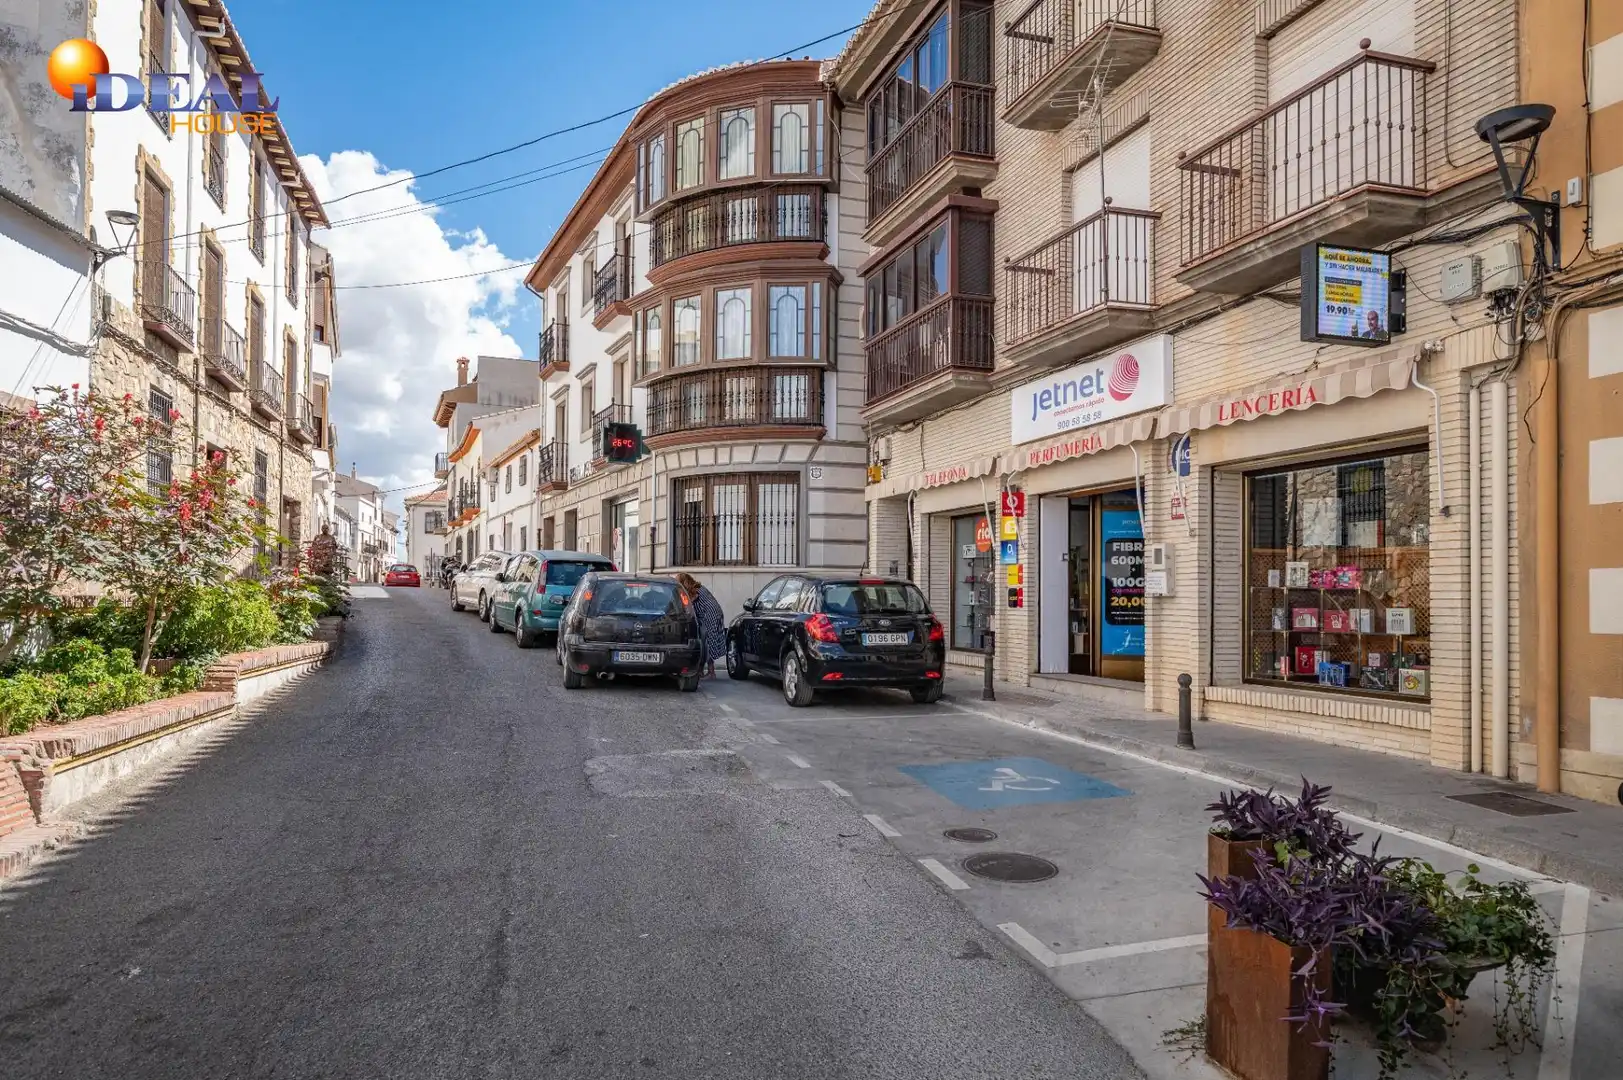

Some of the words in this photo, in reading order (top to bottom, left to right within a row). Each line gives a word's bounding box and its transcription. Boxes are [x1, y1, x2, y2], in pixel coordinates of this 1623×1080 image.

[1031, 368, 1105, 421] jetnet
[1057, 419, 1070, 430] 900
[1071, 416, 1081, 426] 58
[1082, 413, 1091, 424] 58
[1093, 410, 1102, 421] 58
[1112, 542, 1144, 552] FIBR
[868, 633, 888, 643] 0196
[890, 633, 906, 643] GPN
[620, 652, 640, 661] 6035
